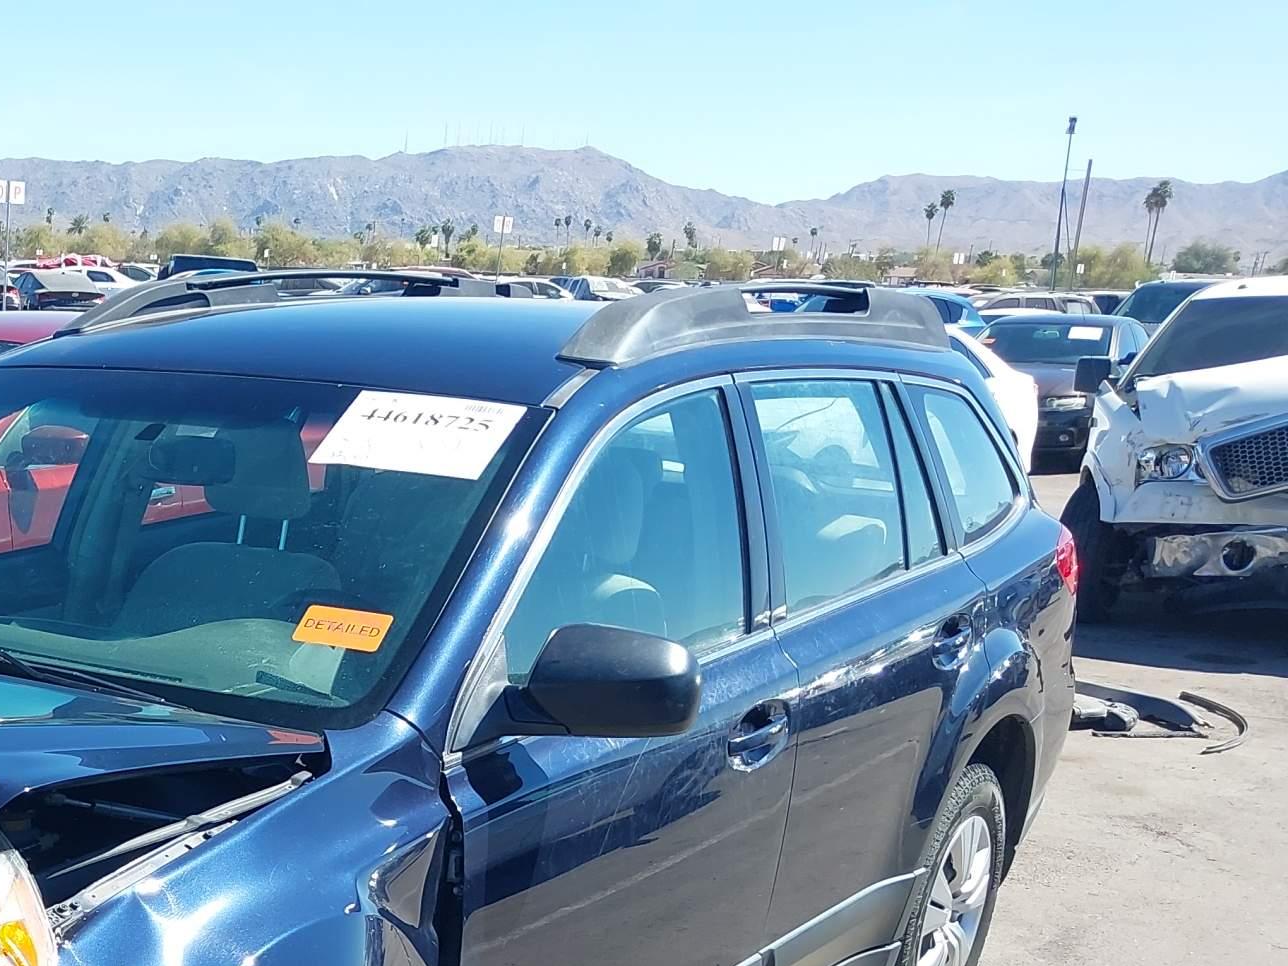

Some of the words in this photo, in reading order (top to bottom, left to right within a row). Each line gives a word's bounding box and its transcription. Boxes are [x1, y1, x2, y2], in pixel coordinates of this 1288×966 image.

[14, 185, 22, 200] P
[360, 407, 496, 432] 44618725
[303, 618, 381, 638] DETAILED
